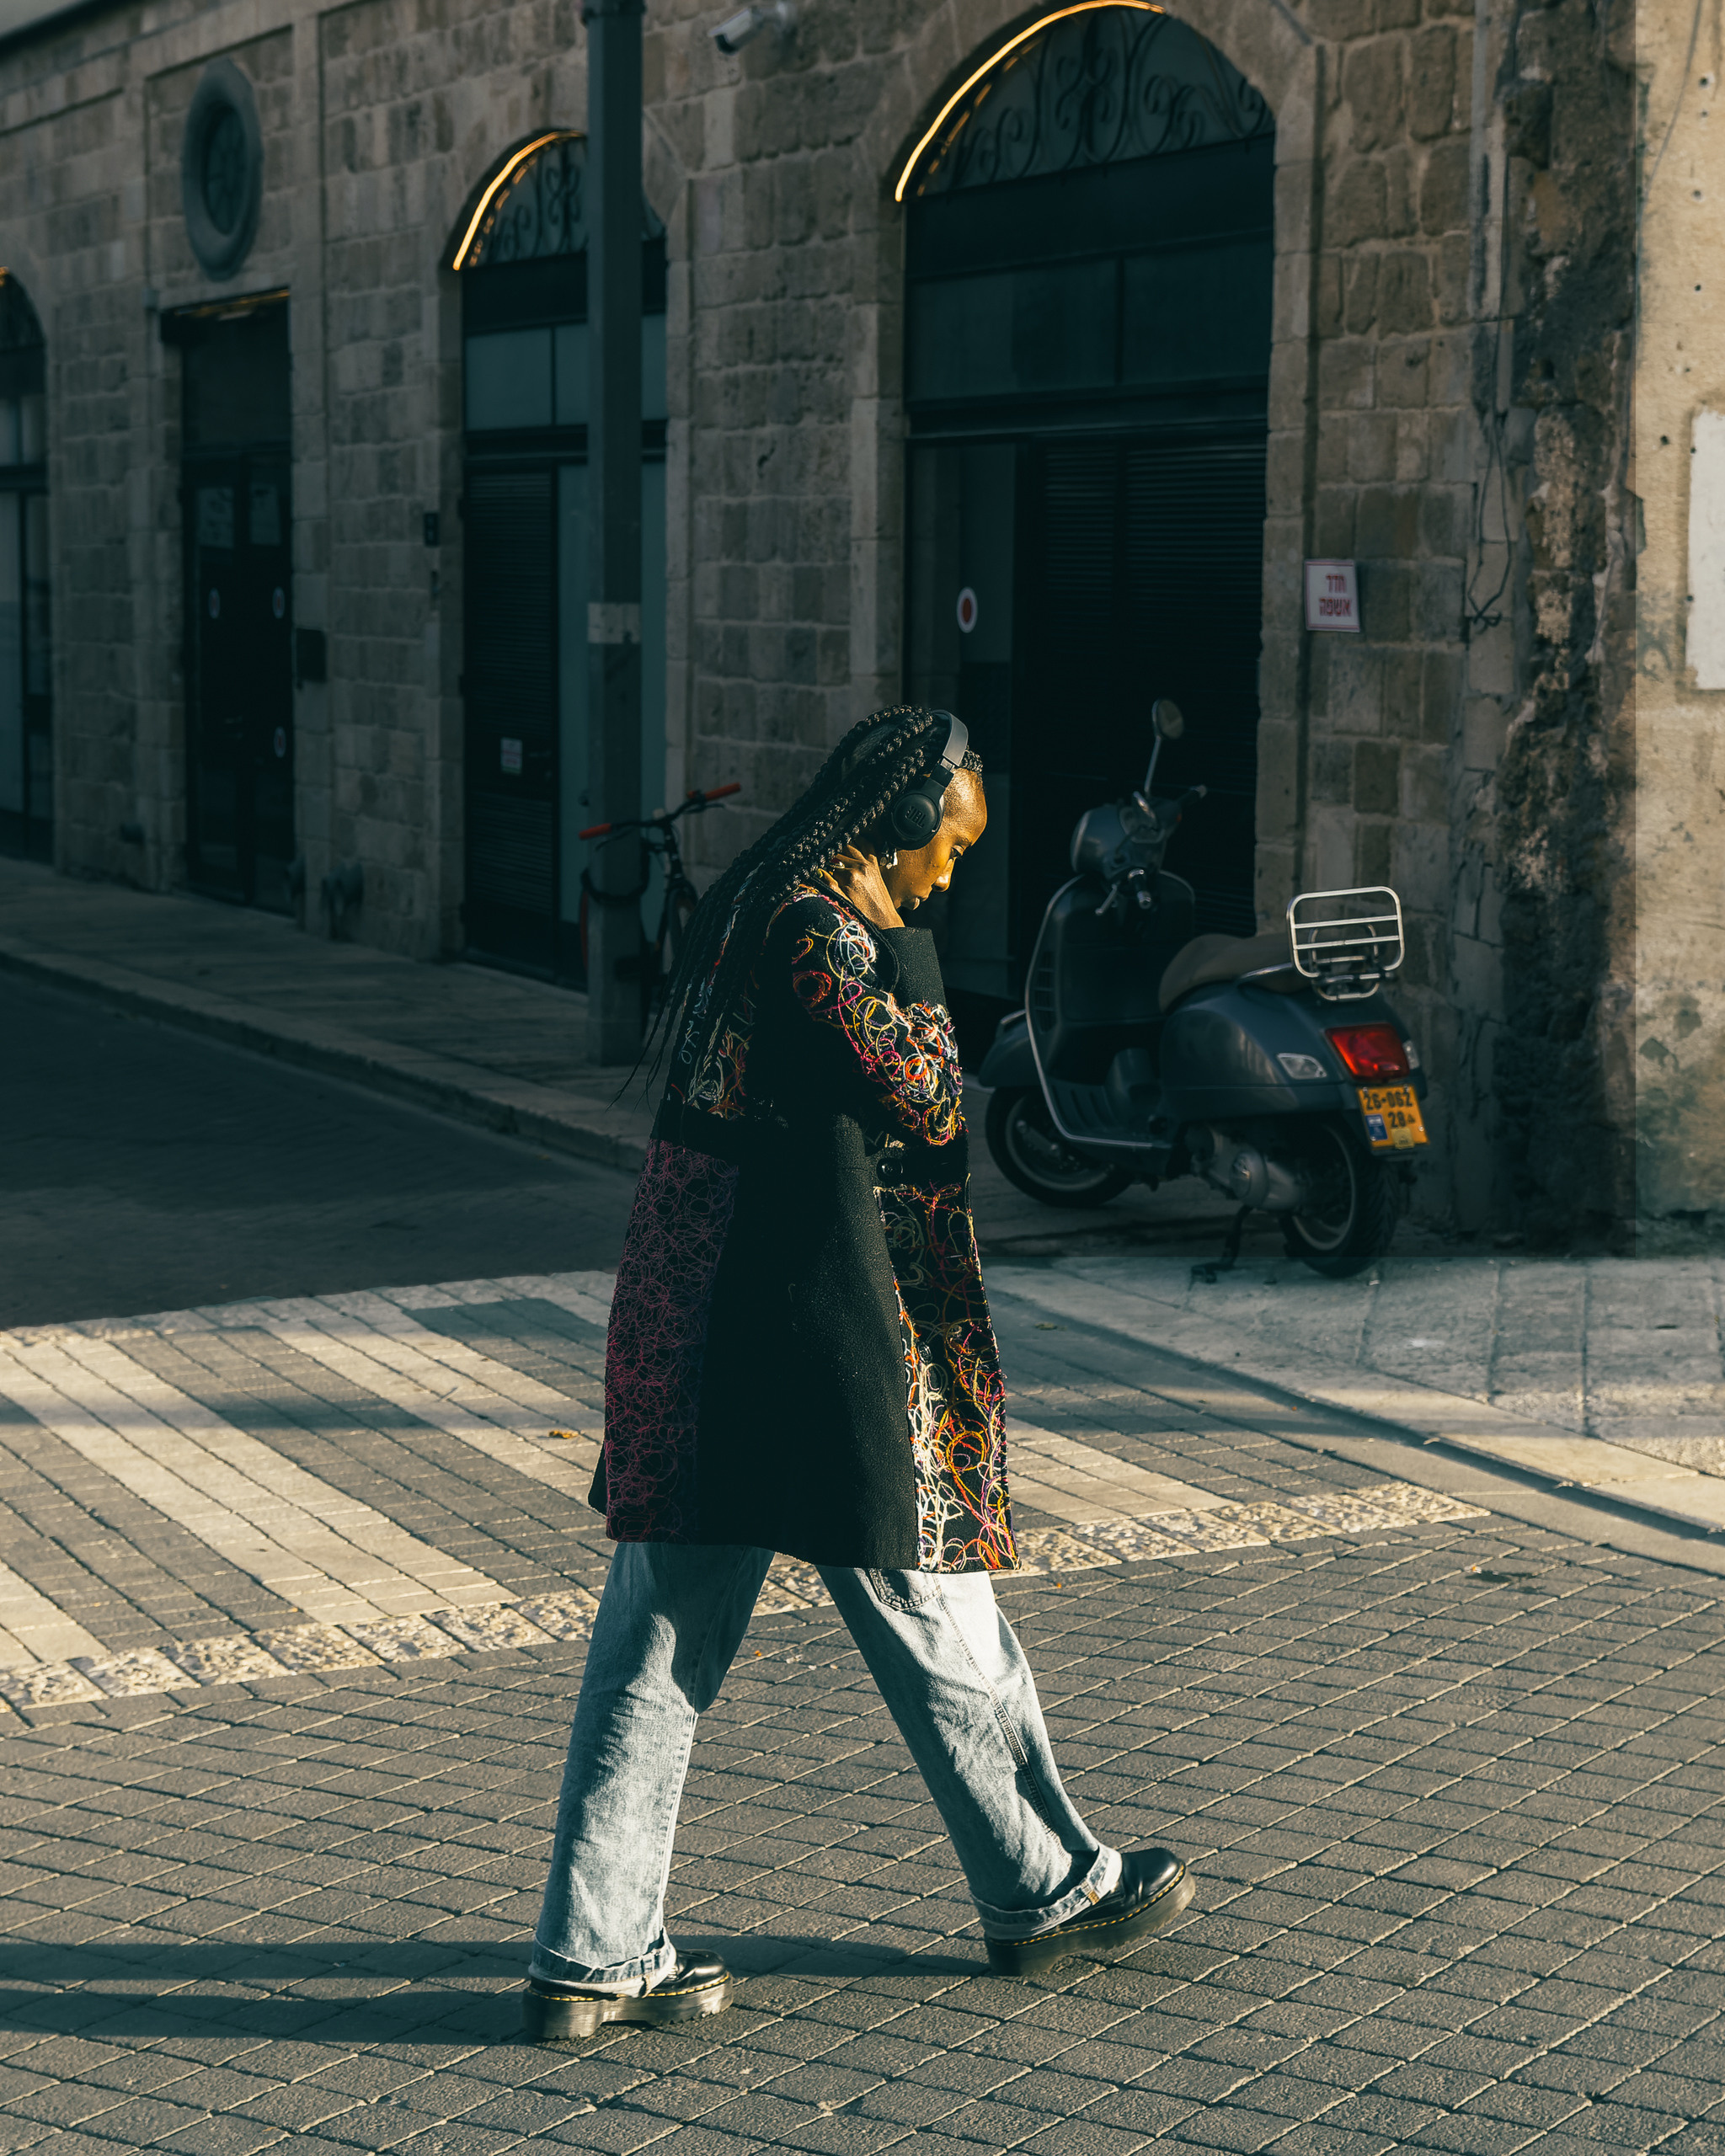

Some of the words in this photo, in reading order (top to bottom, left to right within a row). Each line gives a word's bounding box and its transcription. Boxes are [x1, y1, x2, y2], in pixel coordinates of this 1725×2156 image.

[1326, 574, 1347, 593] חדר
[1319, 598, 1352, 616] אשפה
[905, 806, 926, 828] JBL
